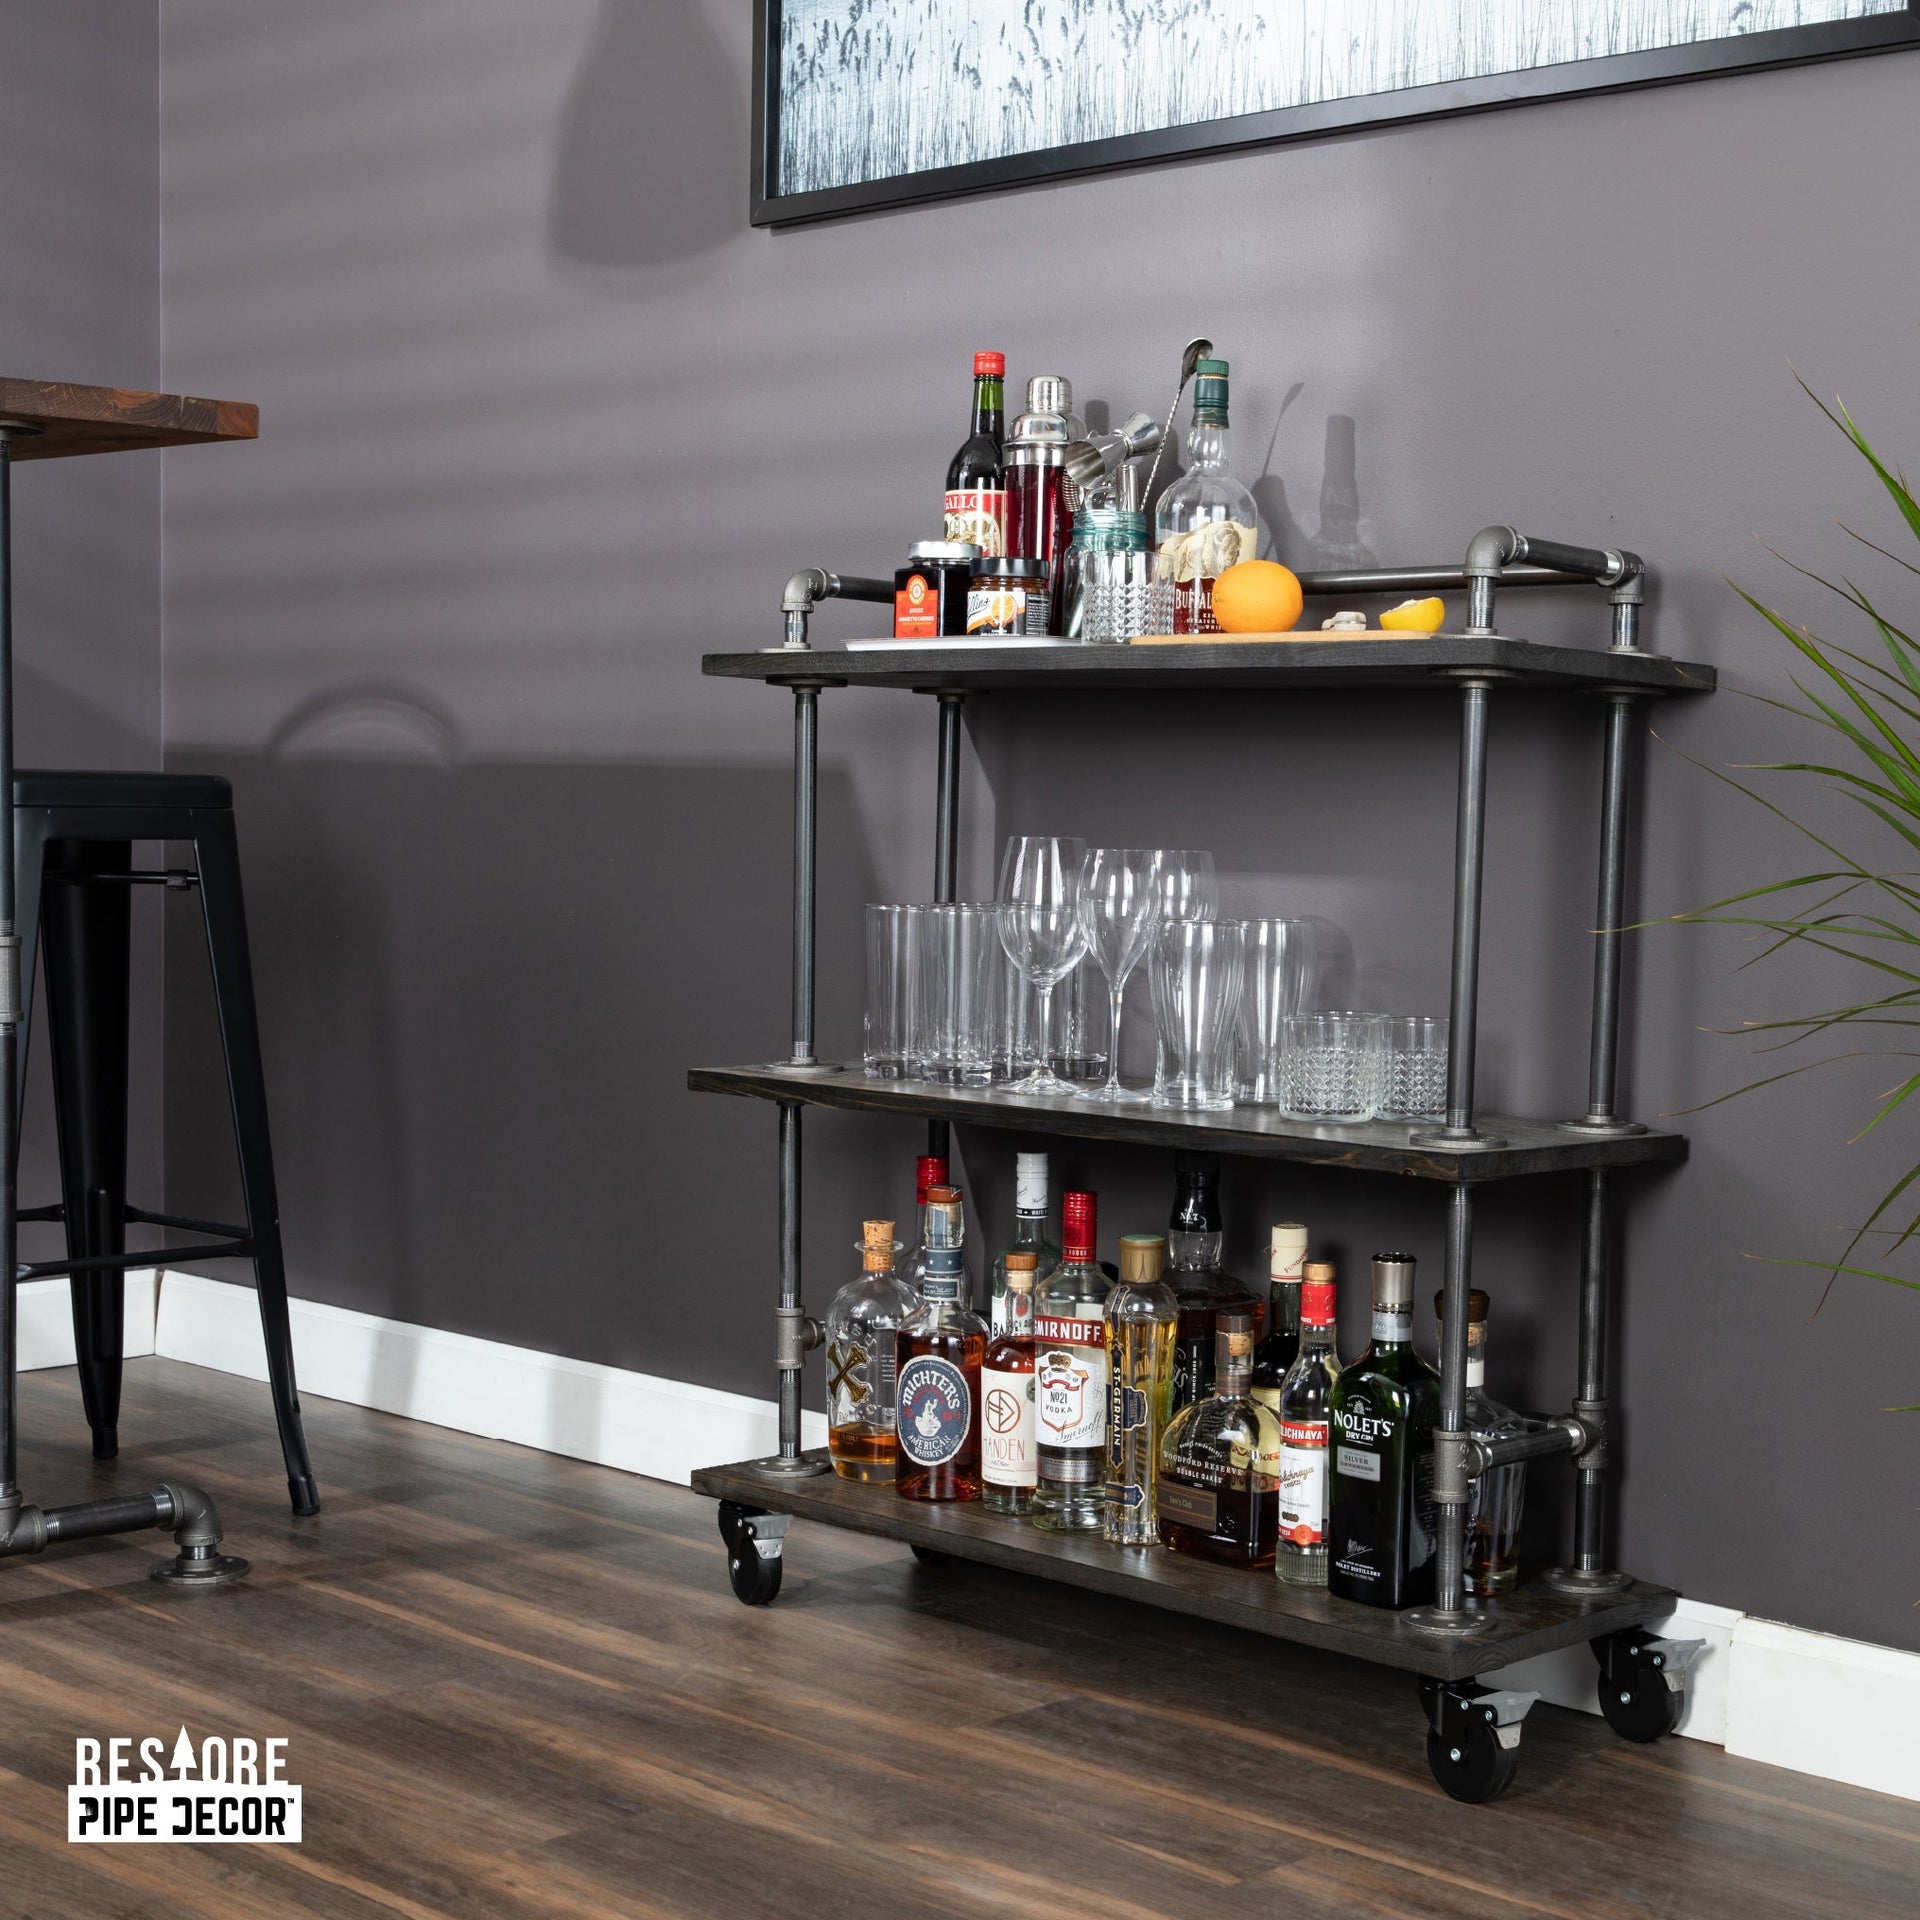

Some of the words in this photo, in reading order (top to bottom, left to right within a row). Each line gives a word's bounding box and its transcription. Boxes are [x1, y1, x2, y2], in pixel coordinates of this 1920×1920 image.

[1045, 1404, 1073, 1413] VODKA
[907, 1434, 952, 1451] AMERICAN
[1345, 1430, 1360, 1441] DRY
[1360, 1434, 1374, 1442] GIN
[913, 1446, 944, 1459] WHISKEY
[1163, 1451, 1202, 1467] WOODFORD
[1204, 1461, 1245, 1476] RESERVE
[1343, 1454, 1369, 1465] SILVER
[1176, 1466, 1199, 1479] DOUBLE
